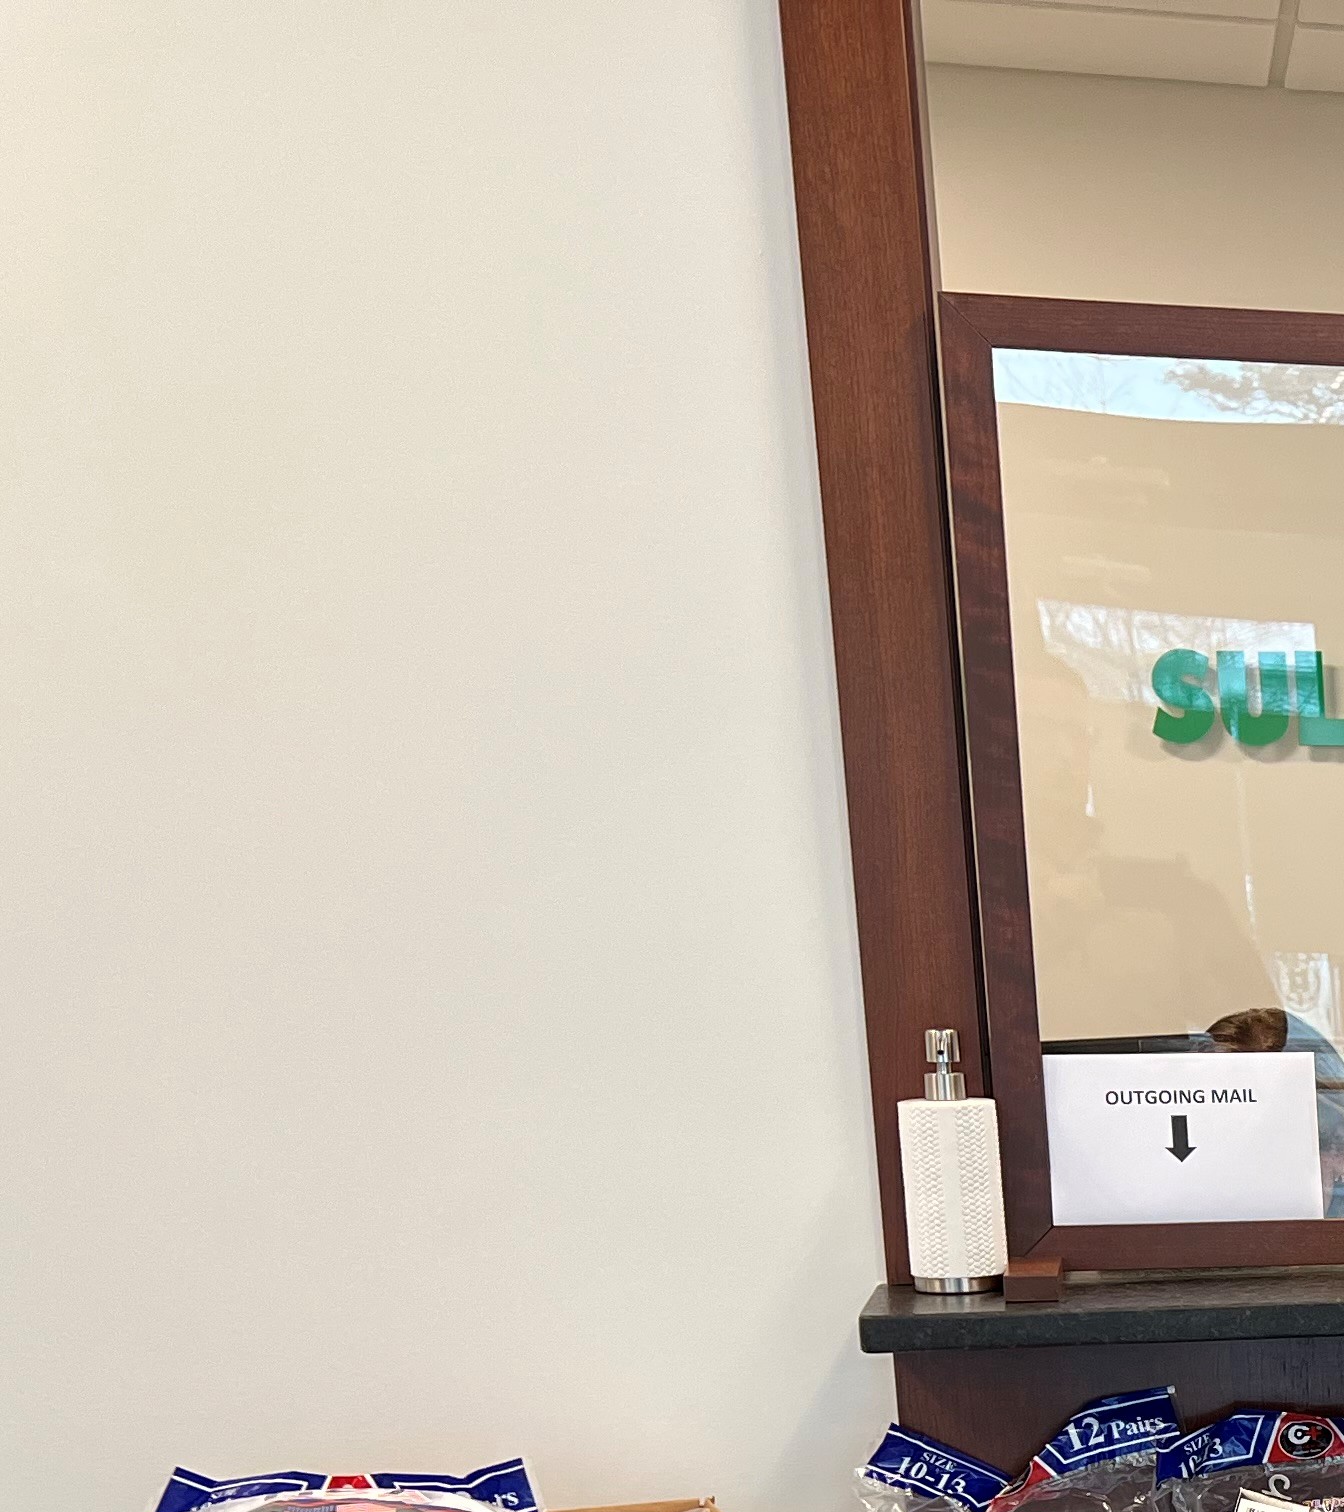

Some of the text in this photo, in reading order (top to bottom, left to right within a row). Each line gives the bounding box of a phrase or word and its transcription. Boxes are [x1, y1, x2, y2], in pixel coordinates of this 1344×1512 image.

[1105, 1089, 1258, 1106] OUTGOING MAIL
[1063, 1415, 1165, 1452] 12 Pairs
[1184, 1434, 1210, 1455] SIZE
[922, 1452, 957, 1472] SIZE
[897, 1456, 966, 1494] 10-13
